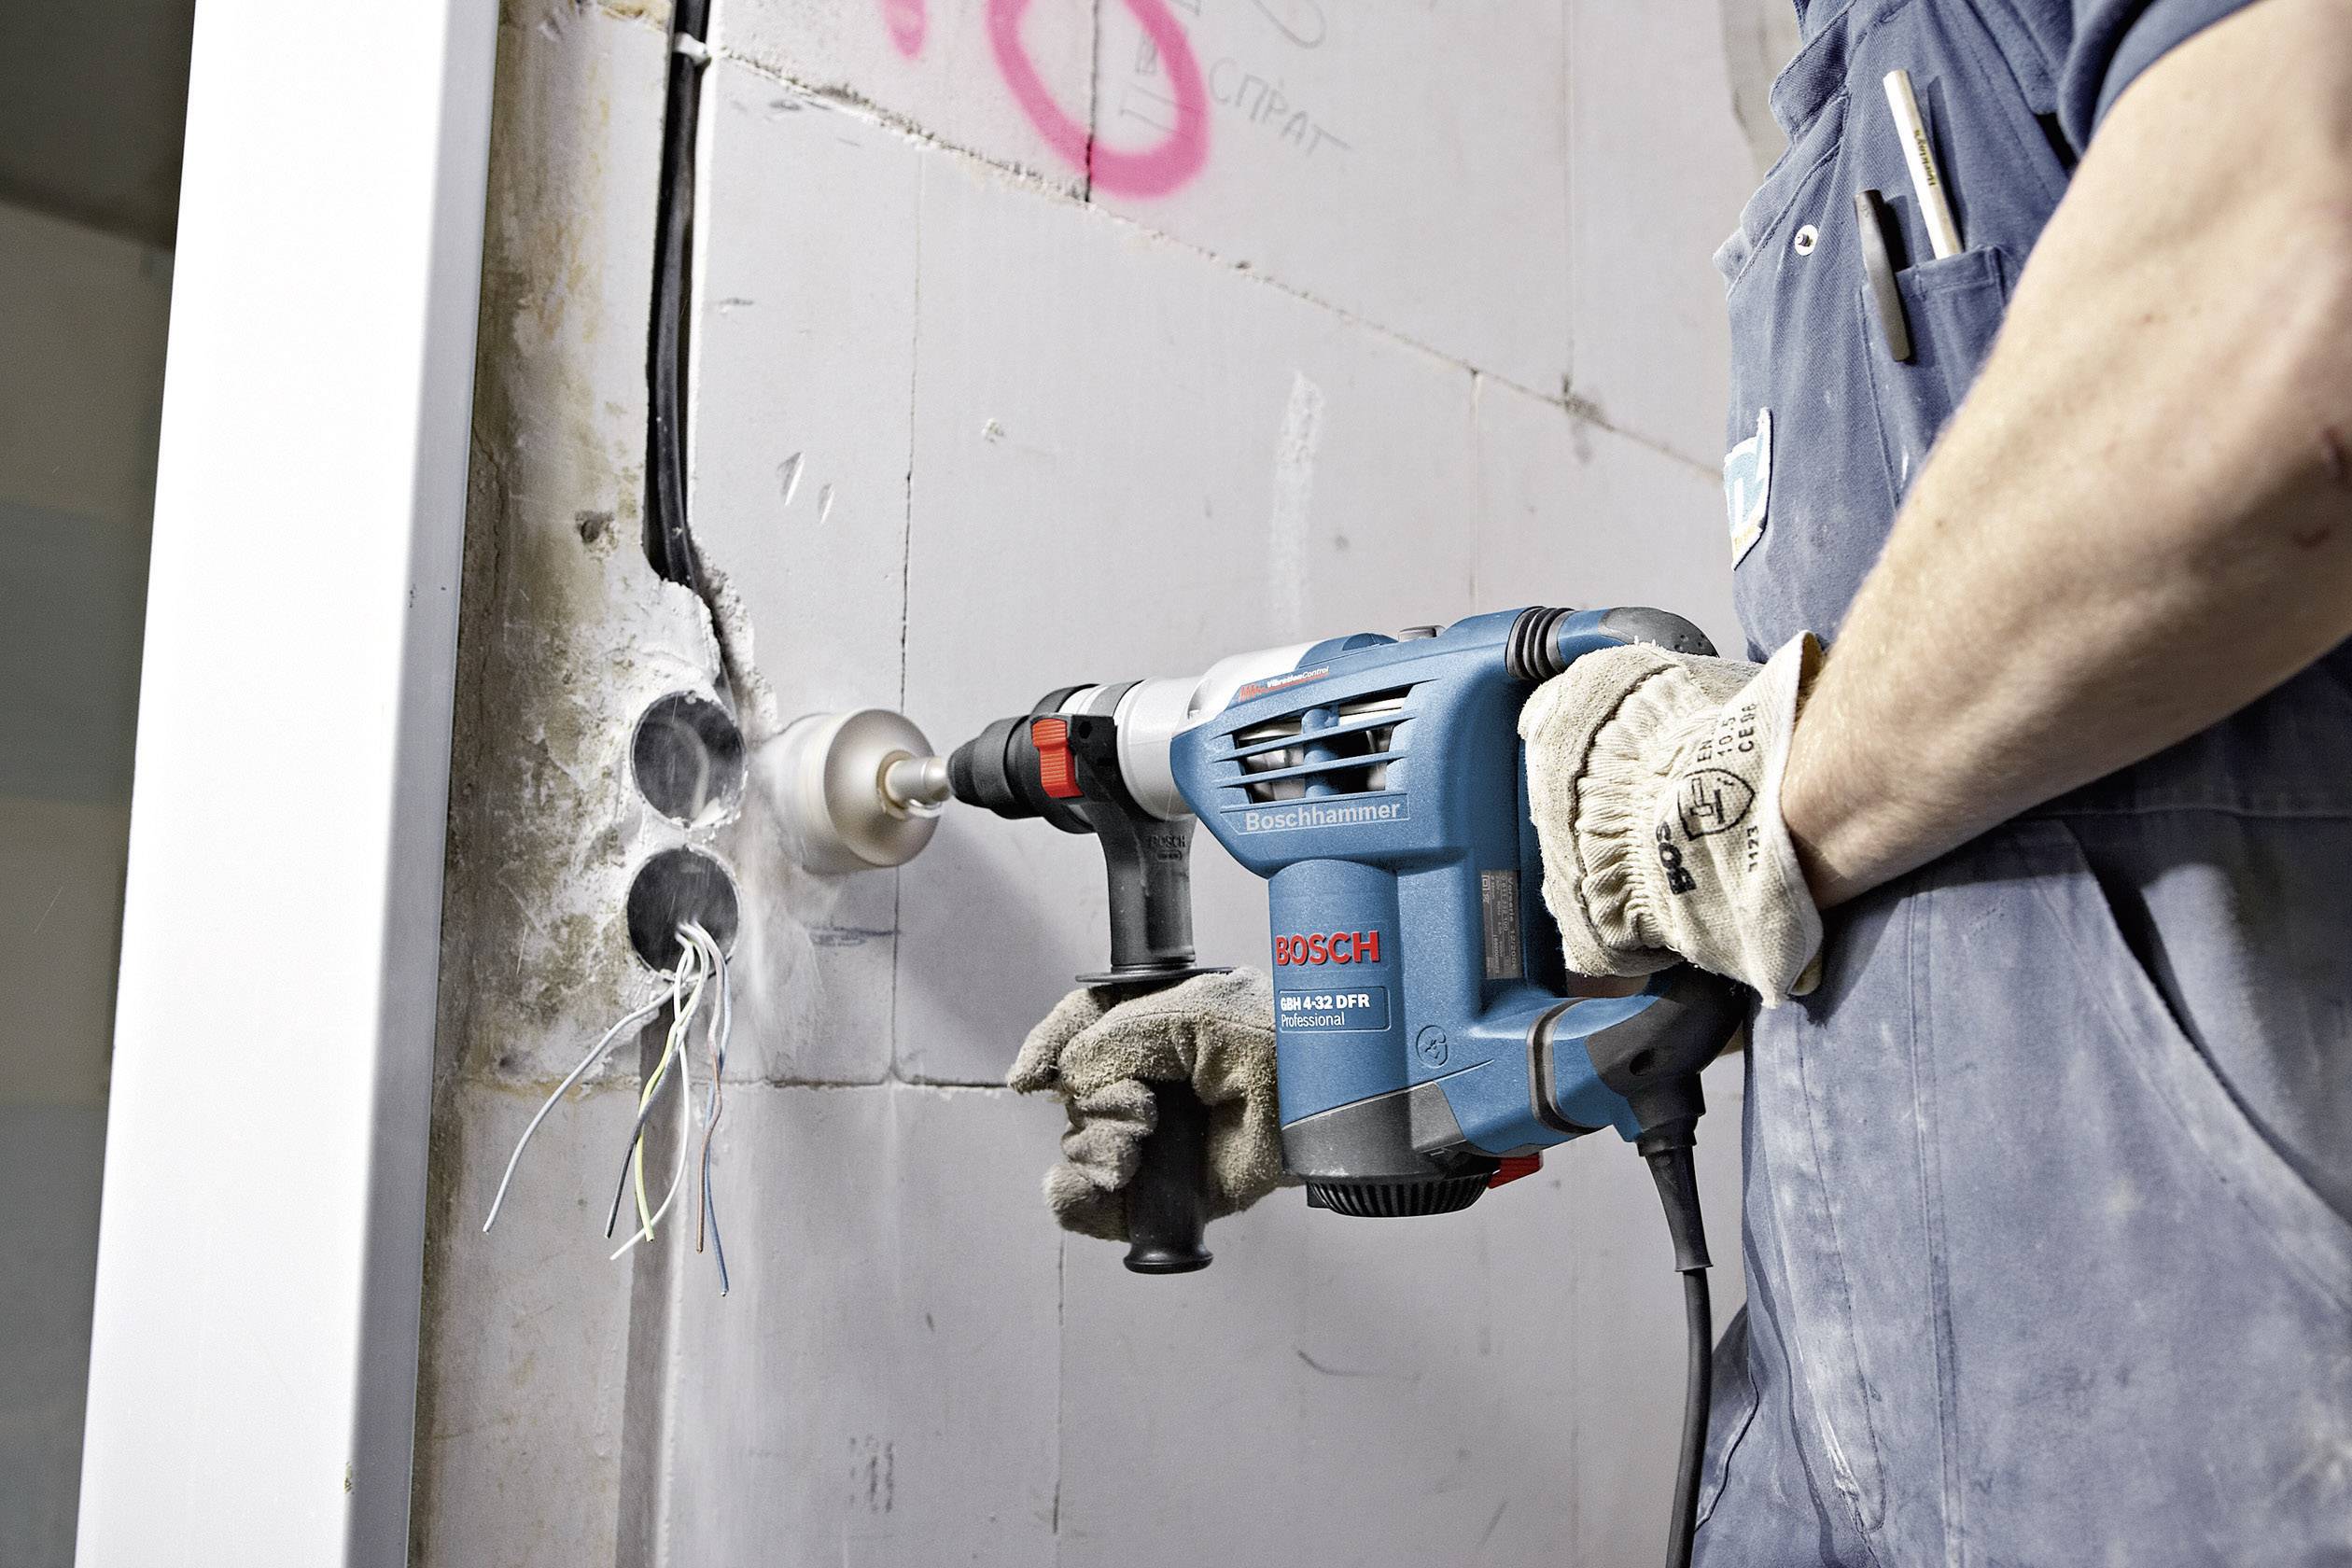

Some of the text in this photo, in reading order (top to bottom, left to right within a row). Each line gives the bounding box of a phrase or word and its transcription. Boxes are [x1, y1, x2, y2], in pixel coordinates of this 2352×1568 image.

[1244, 804, 1400, 832] Boschhammer
[1275, 930, 1380, 966] BOSCH
[1280, 993, 1371, 1012] GBH 4-32 DFR
[1281, 1011, 1345, 1028] Professional
